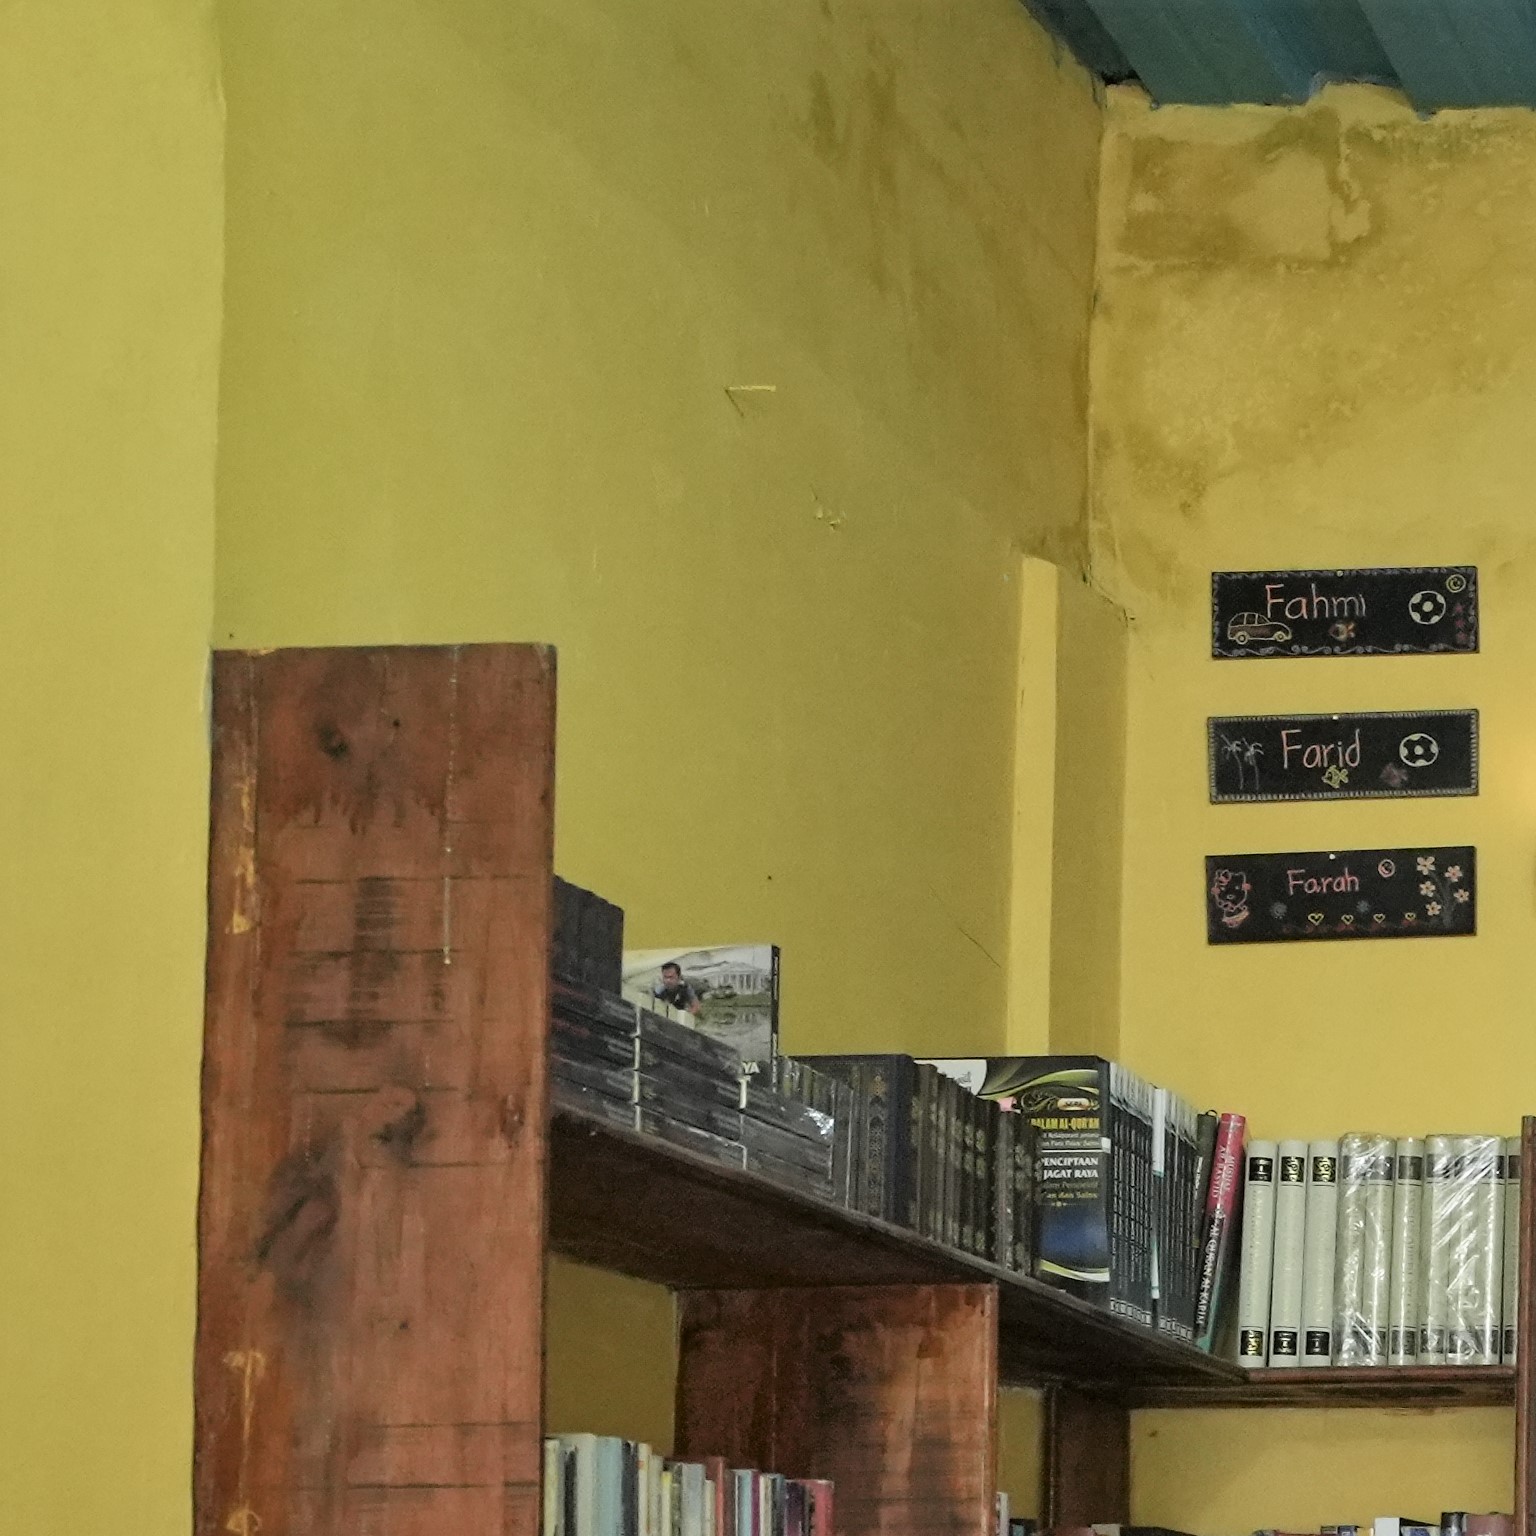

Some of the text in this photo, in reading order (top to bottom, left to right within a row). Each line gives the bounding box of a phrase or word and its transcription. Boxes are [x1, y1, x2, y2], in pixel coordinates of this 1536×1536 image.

[1264, 583, 1367, 620] Fahmi
[1280, 729, 1361, 769] Farid
[1287, 867, 1360, 895] Farah
[1043, 1168, 1099, 1180] JAGAT RAYA
